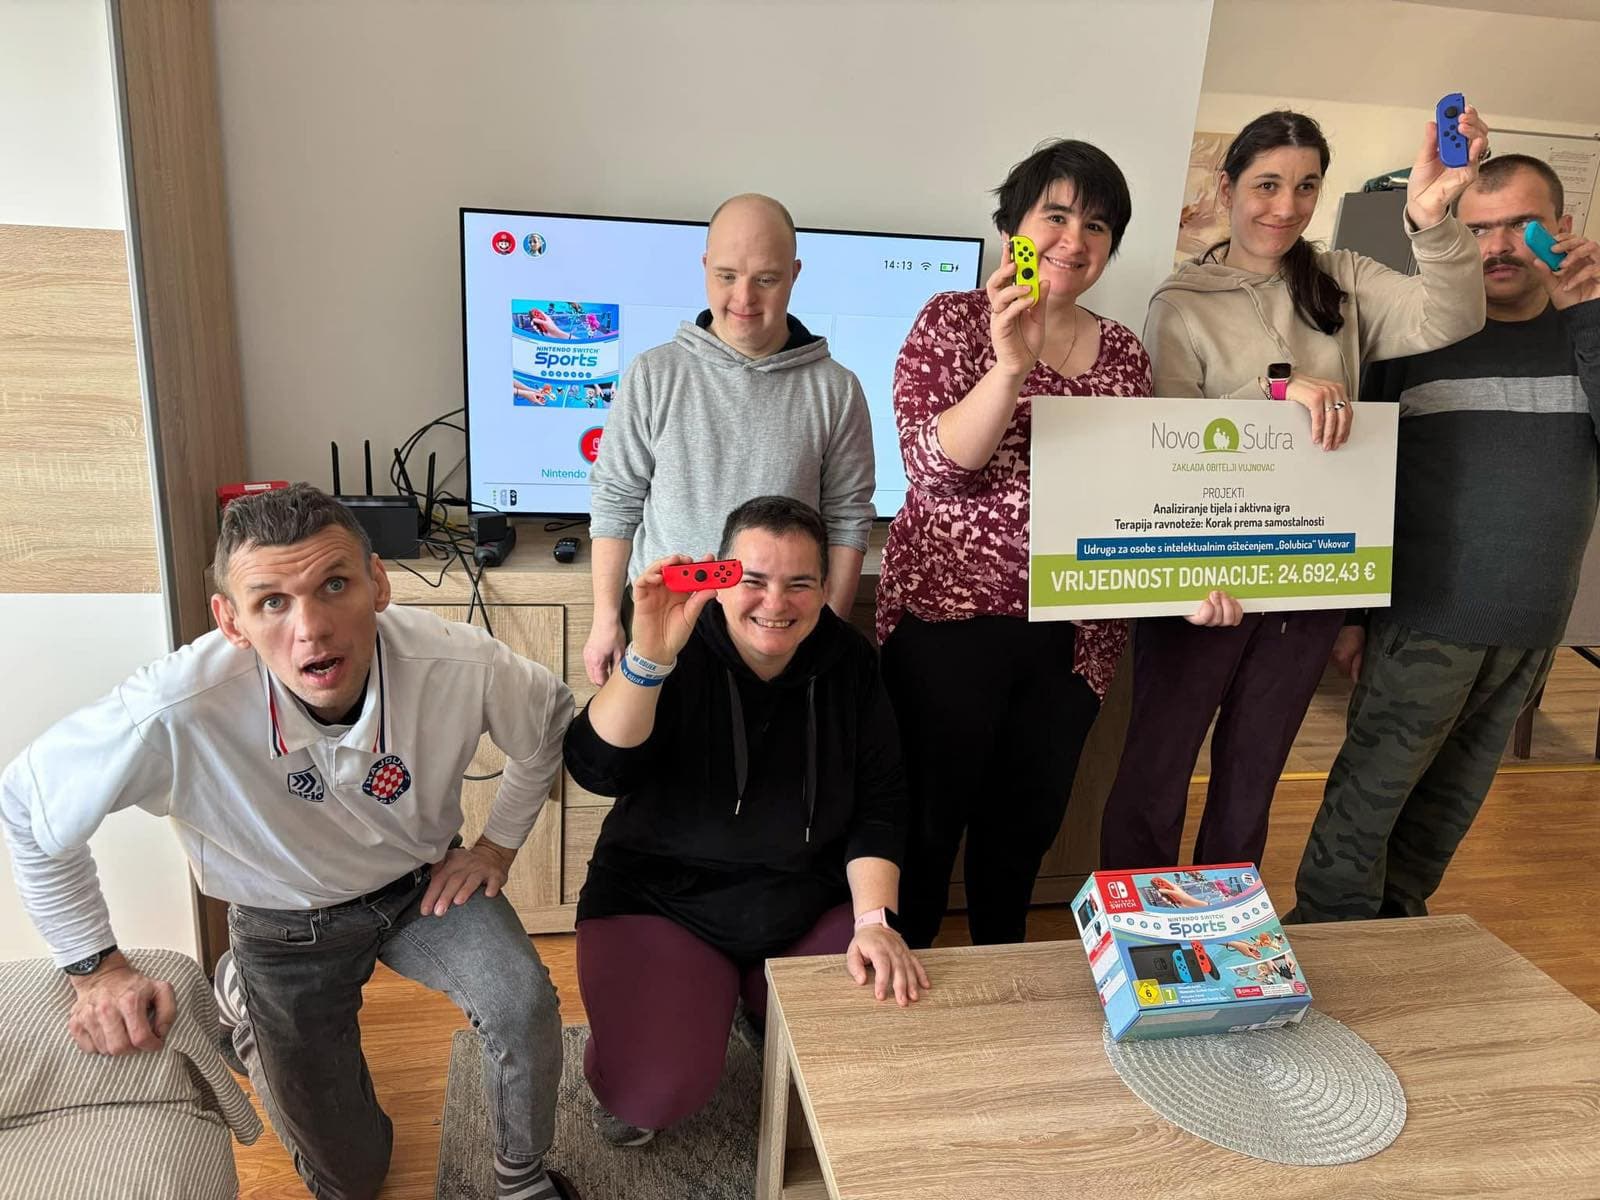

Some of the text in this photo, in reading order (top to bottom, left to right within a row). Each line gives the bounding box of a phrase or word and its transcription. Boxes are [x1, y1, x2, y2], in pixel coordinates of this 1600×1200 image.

[884, 260, 913, 270] 14:13
[534, 352, 598, 369] Sports
[1151, 422, 1294, 450] Novo Sutra
[541, 468, 587, 478] Nintendo
[1172, 463, 1275, 472] ZAKLADA OBITELJI VUJNOVAC
[1202, 487, 1245, 499] PROJEKTI
[1153, 502, 1290, 516] Analiziranje tijela i aktivna igra
[1114, 516, 1325, 532] Terapija ravnoteže: Korak prema samostalnosti
[1083, 543, 1116, 556] Udruga
[1118, 546, 1128, 554] za
[1129, 543, 1156, 553] osobe
[1157, 545, 1162, 553] s
[1164, 541, 1226, 553] intelektualnim
[1228, 541, 1274, 553] oštećenjem
[1317, 538, 1350, 549] Vukovar
[1051, 561, 1376, 592] VRIJEDNOST DONACIJE: 24.692,43 €
[1110, 901, 1137, 910] SWITCH
[1169, 919, 1228, 937] Sports
[1145, 989, 1152, 998] 6
[1166, 989, 1173, 1000] 7
